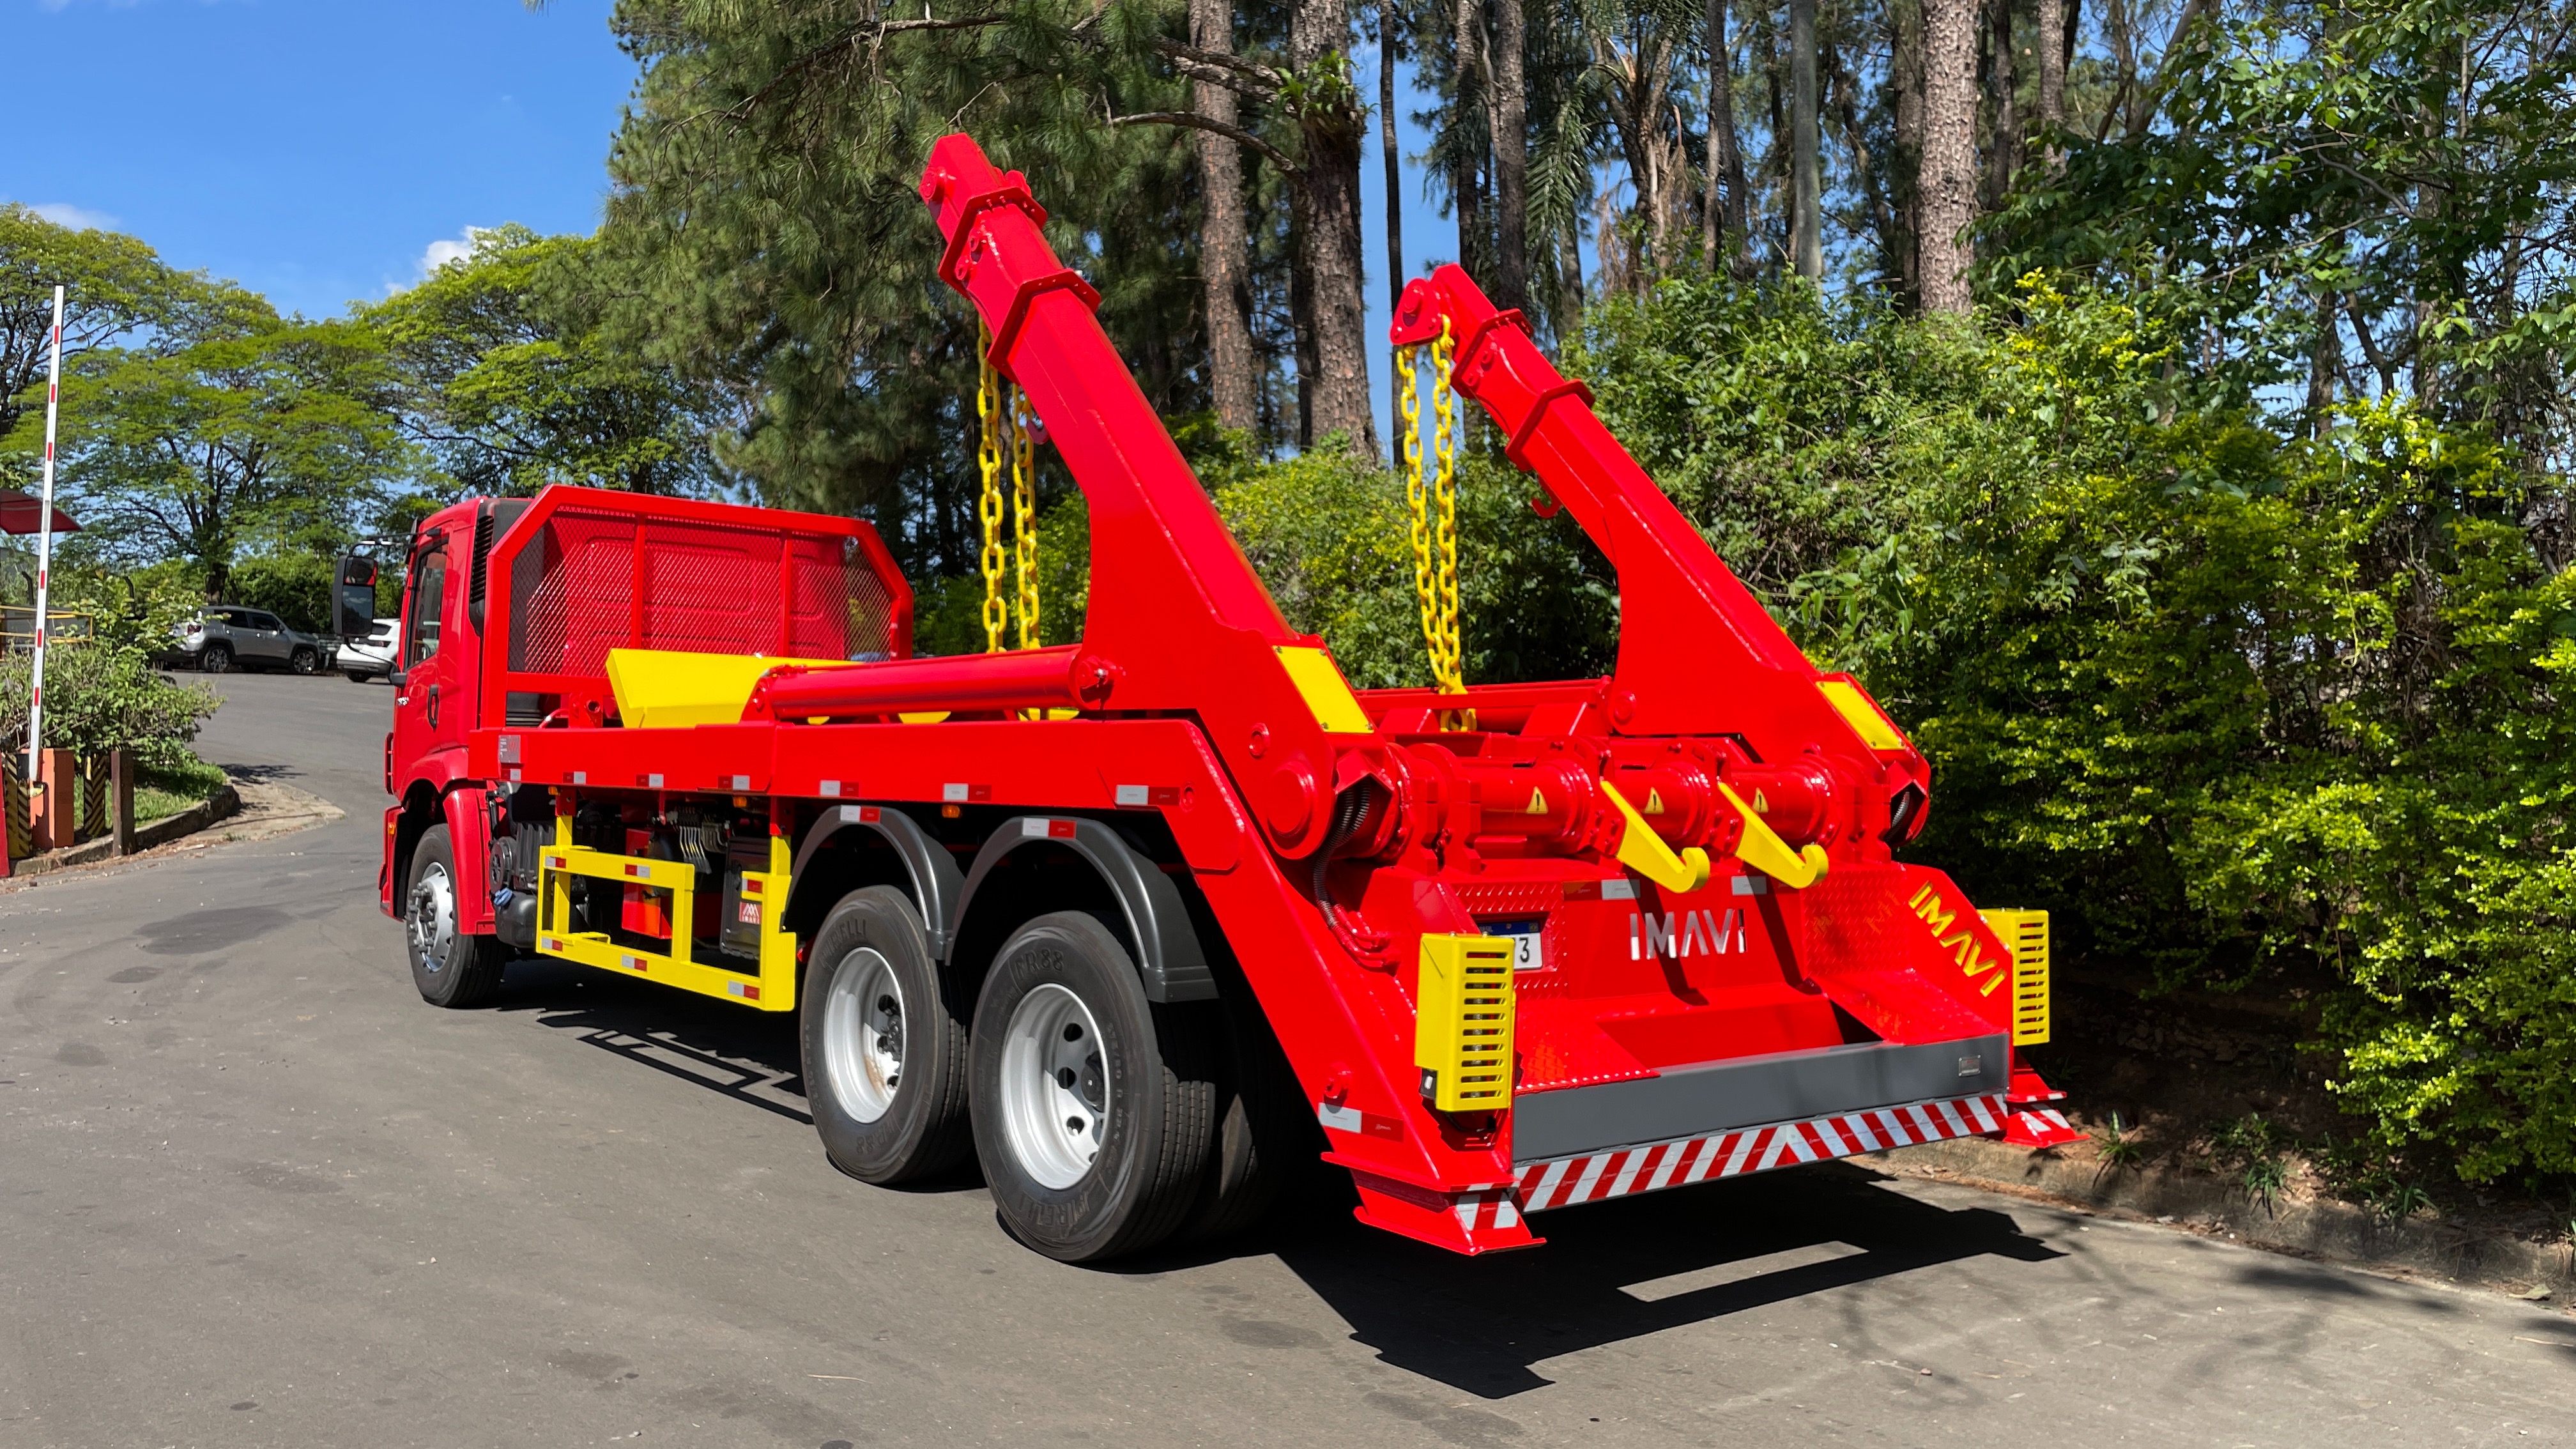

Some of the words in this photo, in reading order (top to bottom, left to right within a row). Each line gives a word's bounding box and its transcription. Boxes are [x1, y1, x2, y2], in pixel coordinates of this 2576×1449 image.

[1630, 908, 1747, 961] IMAVI
[1908, 880, 2007, 997] IMAVI
[1014, 948, 1064, 981] FR88
